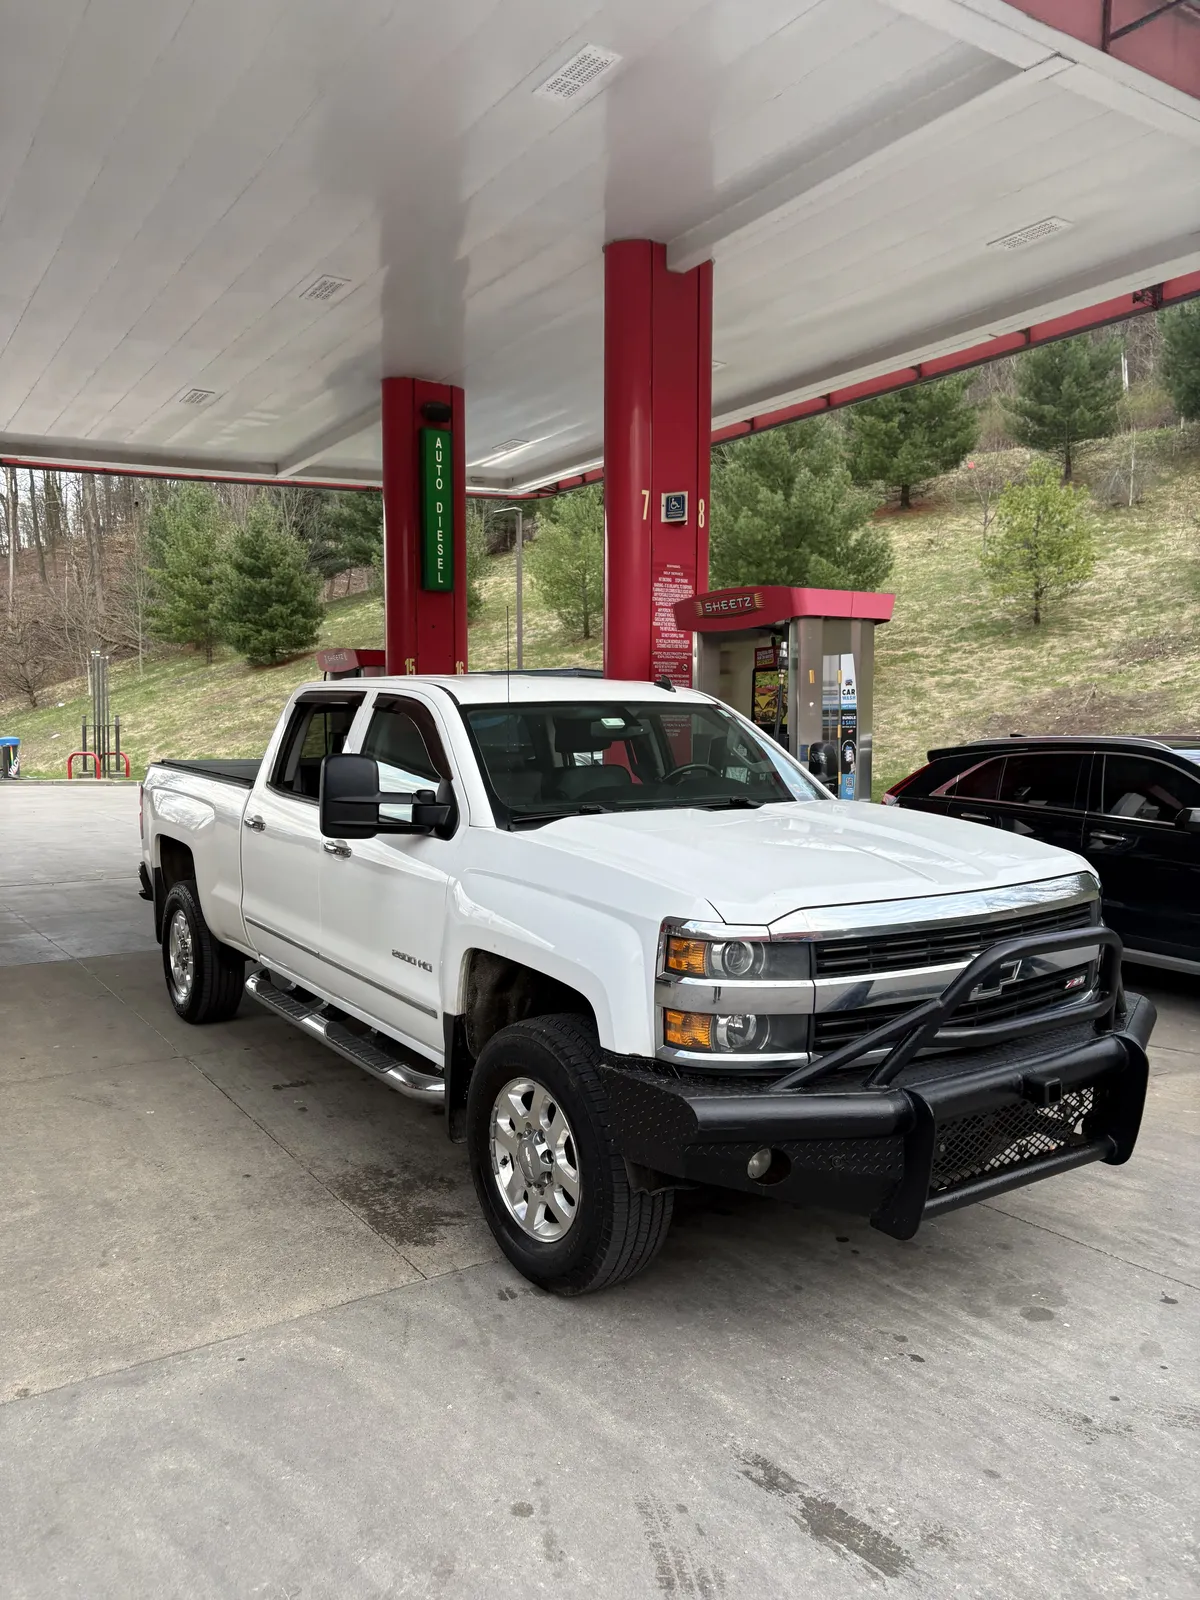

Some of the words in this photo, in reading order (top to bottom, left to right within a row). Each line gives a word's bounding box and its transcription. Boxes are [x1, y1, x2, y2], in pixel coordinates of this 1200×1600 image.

[435, 437, 443, 490] AUTO
[641, 489, 650, 520] 7
[698, 498, 705, 528] 8
[436, 502, 444, 583] DIESEL
[705, 597, 752, 612] SHEETZ
[405, 658, 416, 675] 15
